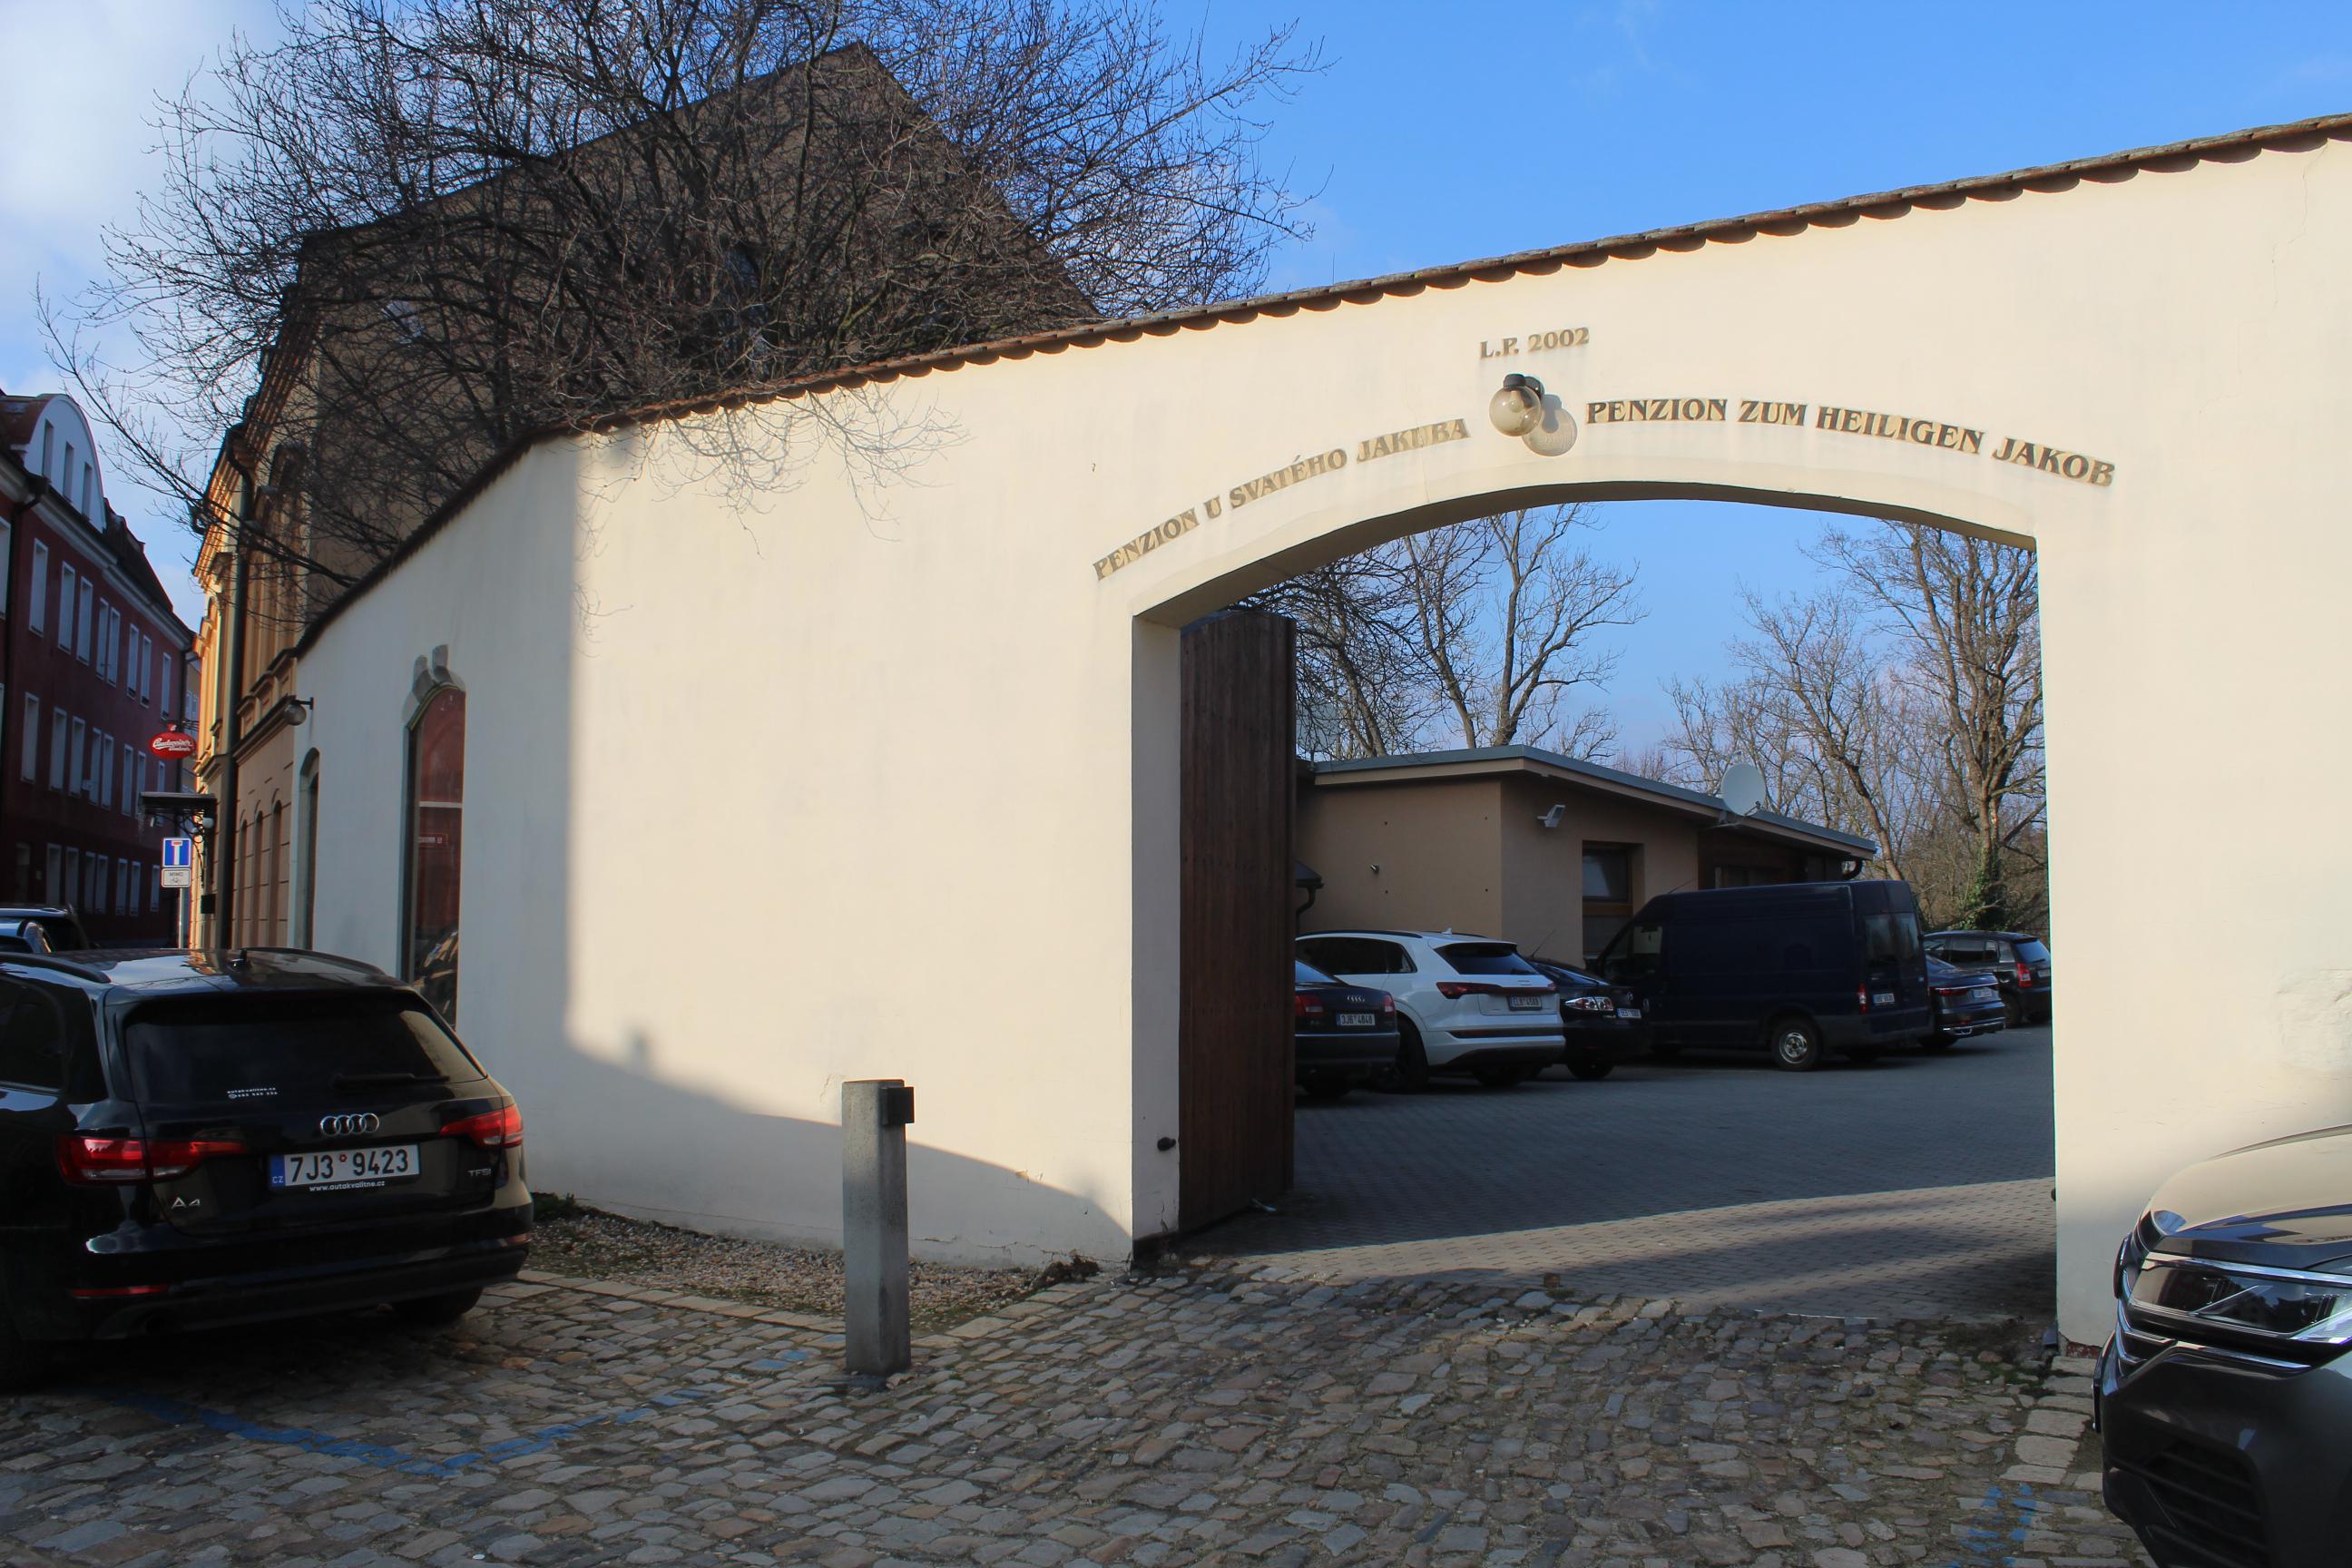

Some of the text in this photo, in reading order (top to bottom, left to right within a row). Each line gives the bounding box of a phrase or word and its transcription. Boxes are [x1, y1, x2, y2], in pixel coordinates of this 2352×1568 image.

[1480, 327, 1590, 359] L.P. 2002
[1585, 398, 2116, 488] PENZION ZUM HEILIGEN JAKOB
[1092, 507, 1200, 582] PENZION
[1203, 495, 1222, 519] U
[1230, 448, 1348, 510] SVATÉHO
[289, 1149, 408, 1183] 7J3 9423
